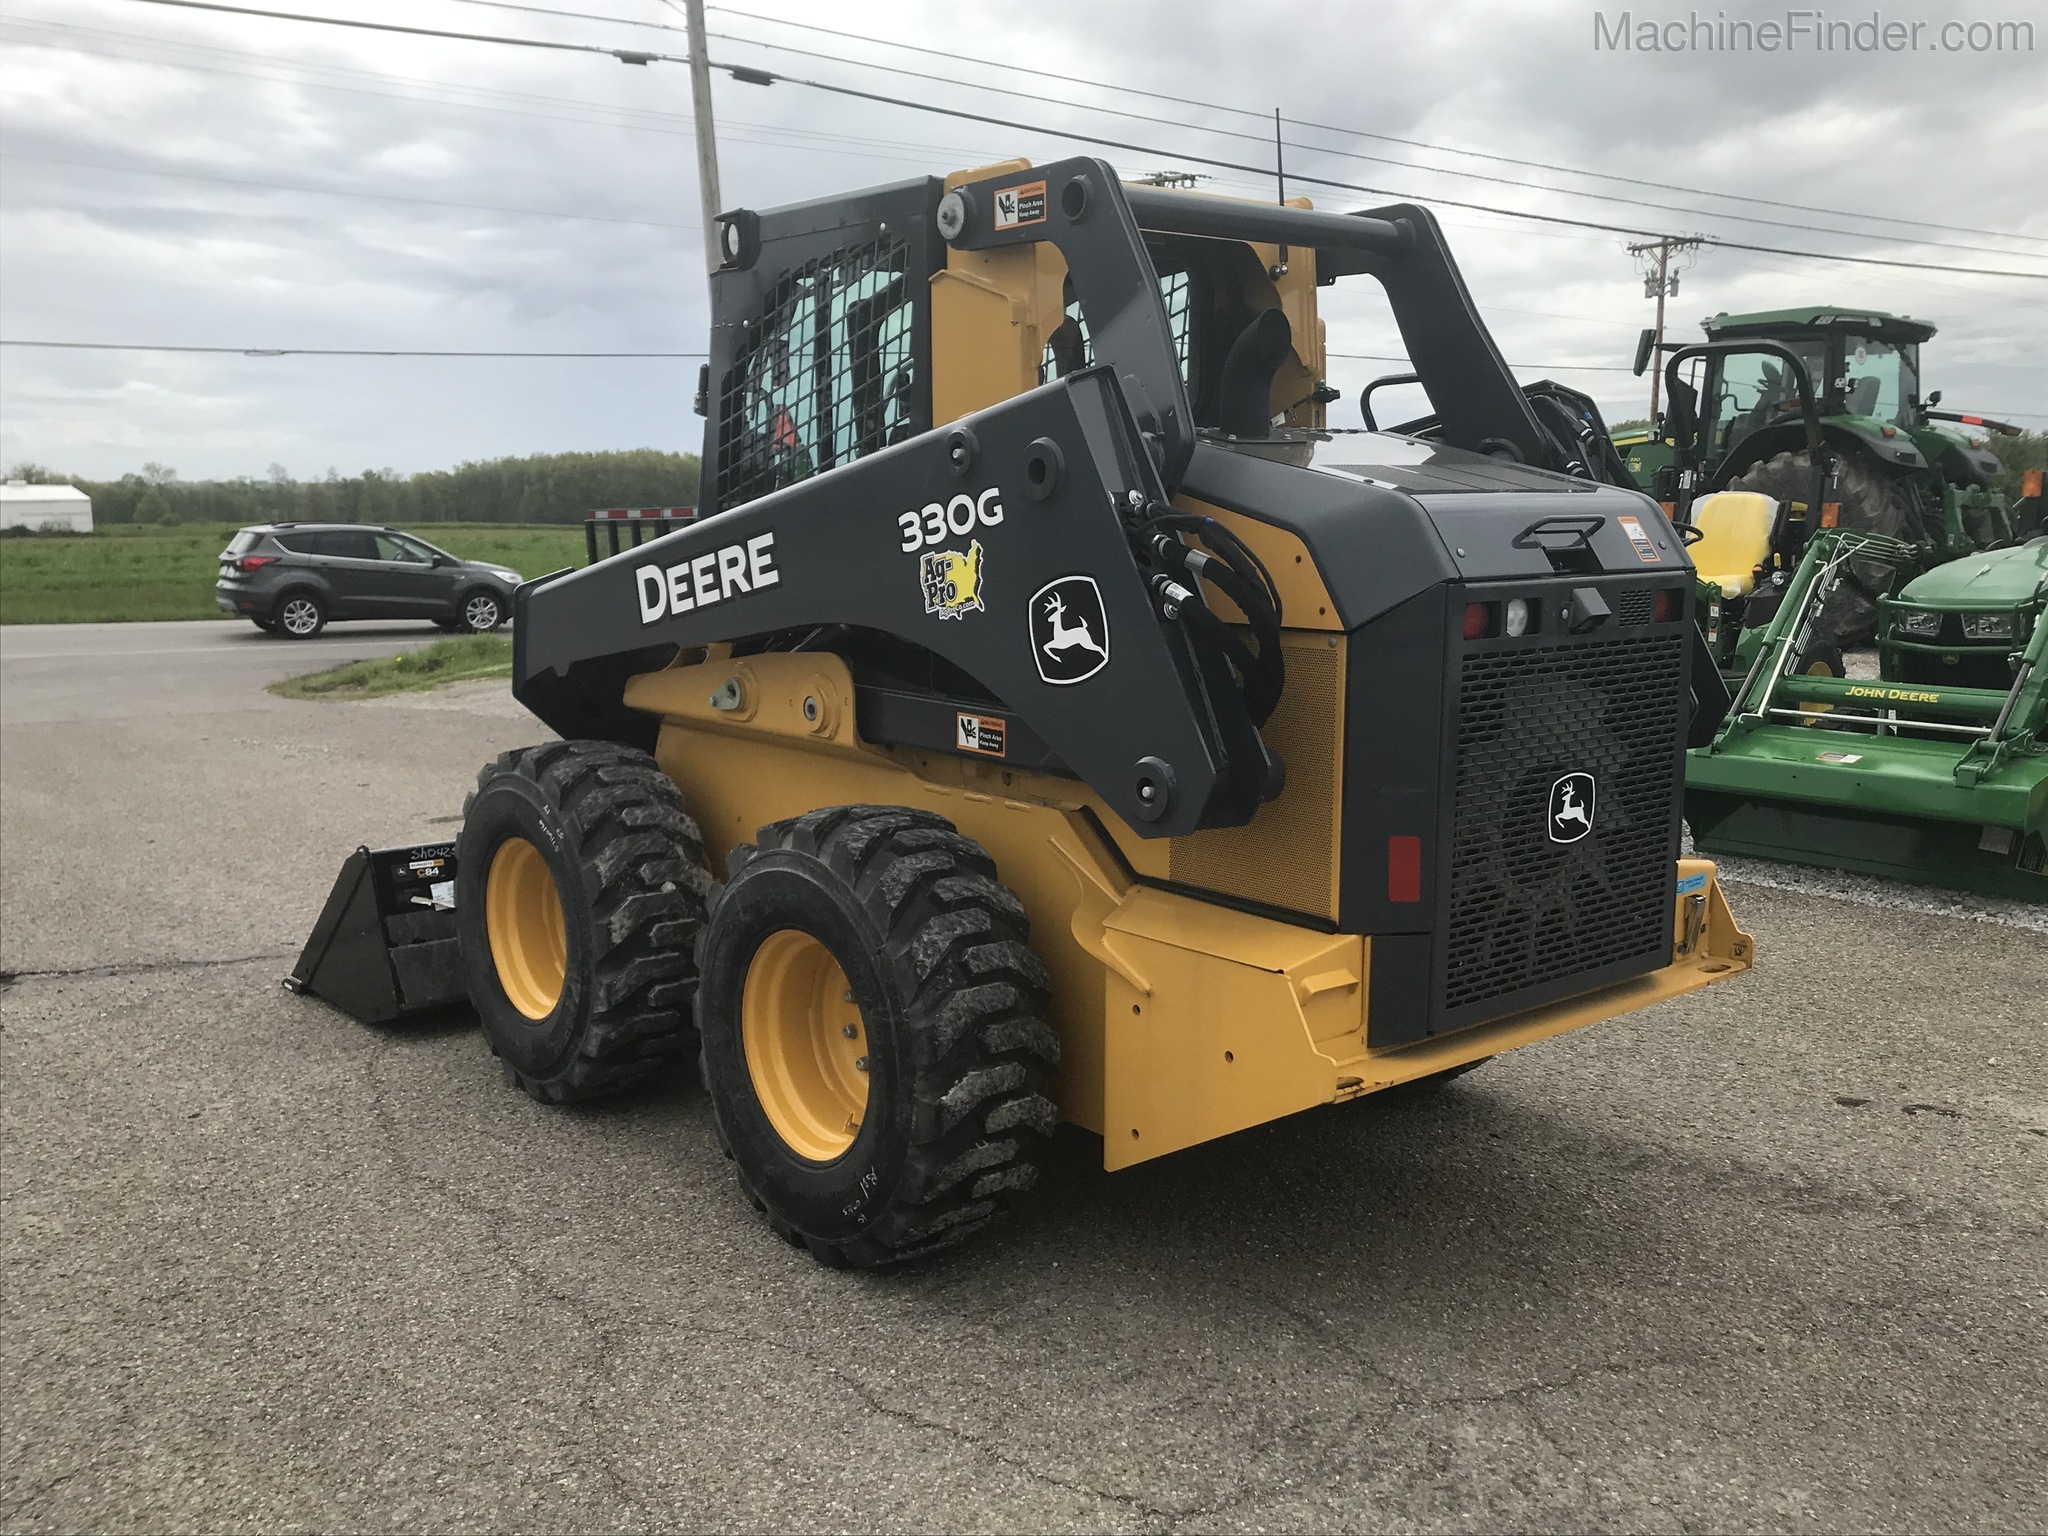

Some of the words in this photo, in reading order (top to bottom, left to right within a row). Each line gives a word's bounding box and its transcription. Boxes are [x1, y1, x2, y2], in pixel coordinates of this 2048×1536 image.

[1019, 202, 1032, 210] Pinch
[898, 488, 1004, 553] 330G
[636, 532, 779, 624] DEERE
[924, 557, 952, 585] Ag-
[926, 581, 957, 609] Pro
[1845, 686, 1885, 698] JOHN
[1888, 689, 1940, 703] DEERE
[980, 732, 991, 740] Pinch
[992, 734, 1002, 742] Area
[989, 741, 999, 749] Away
